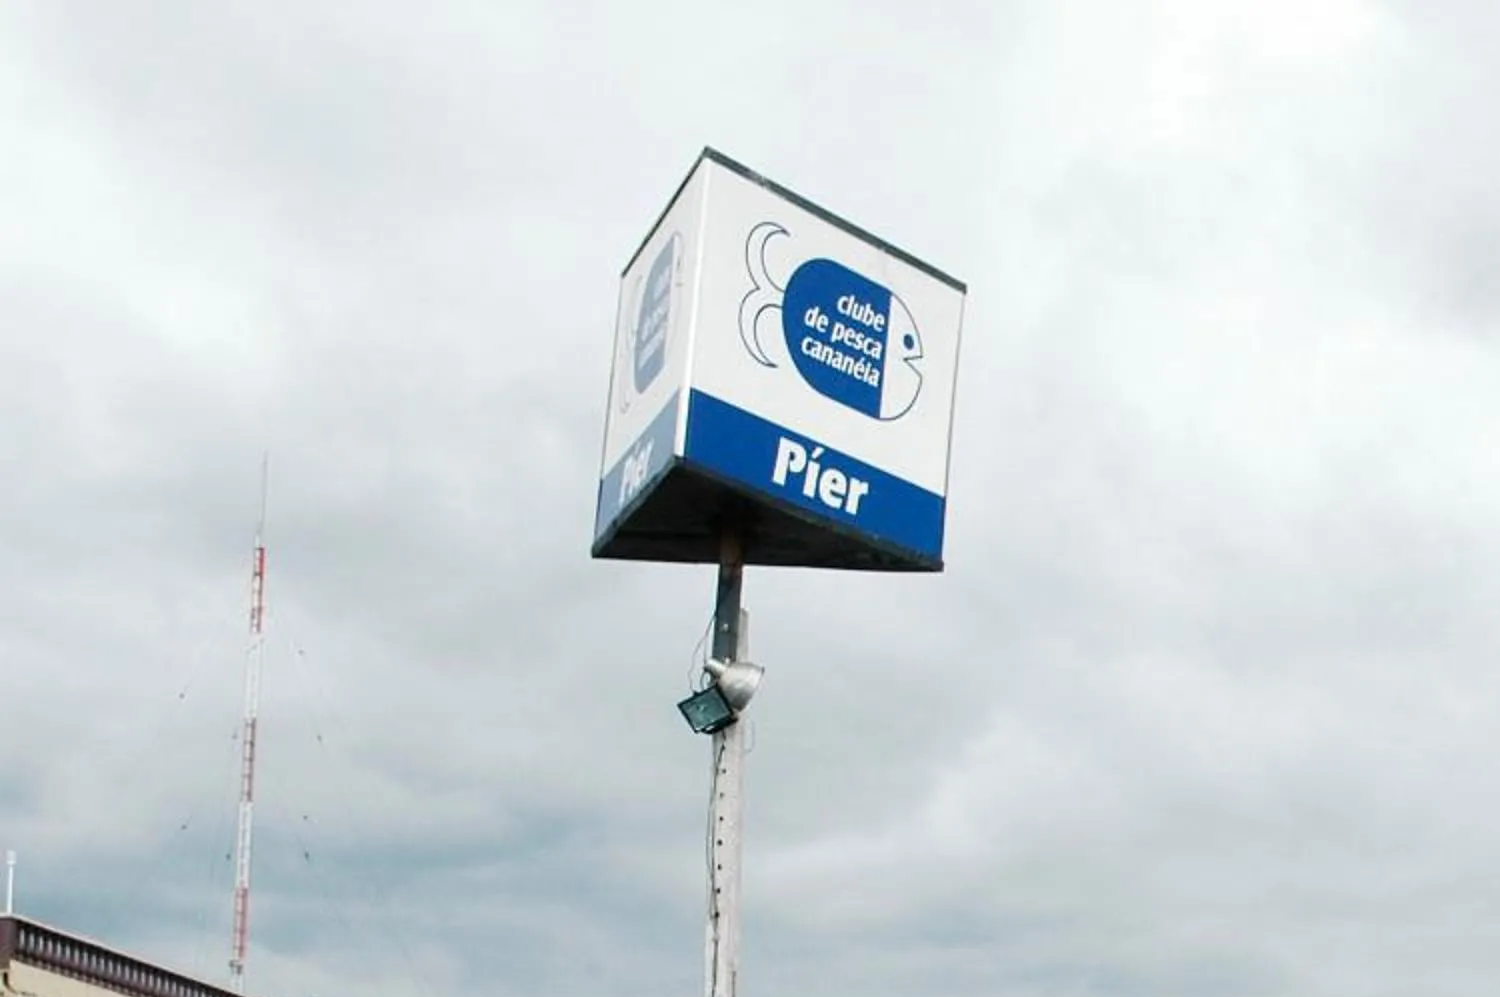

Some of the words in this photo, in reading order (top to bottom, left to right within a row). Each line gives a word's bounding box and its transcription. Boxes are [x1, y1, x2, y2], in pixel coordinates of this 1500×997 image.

[804, 306, 829, 333] de
[831, 321, 882, 359] pesca
[837, 294, 885, 332] clube
[801, 336, 880, 387] cananéia
[772, 436, 869, 515] Píer
